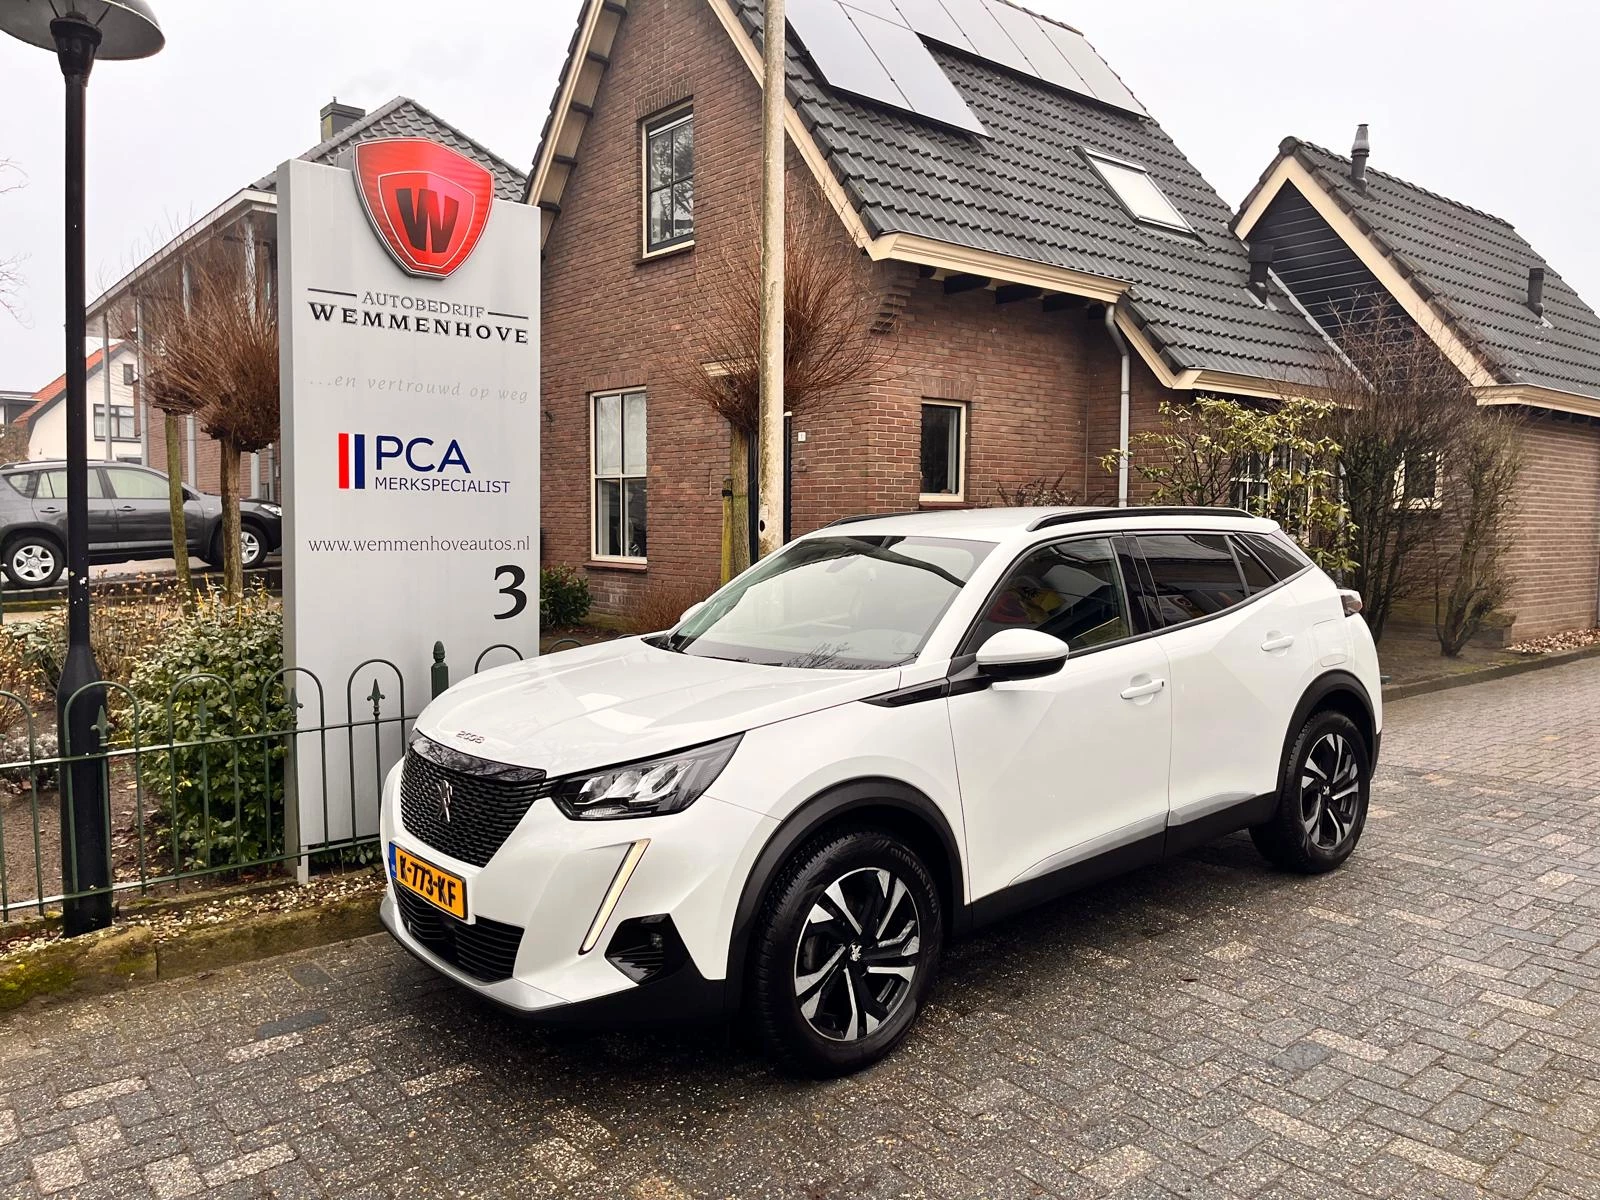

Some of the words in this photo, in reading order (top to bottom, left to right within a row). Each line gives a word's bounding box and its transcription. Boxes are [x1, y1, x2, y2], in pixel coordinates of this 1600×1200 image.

[395, 187, 460, 254] W
[307, 301, 529, 345] WEMMENHOVE
[361, 290, 486, 318] AUTOBEDRIJF
[367, 376, 462, 396] vertrouwd
[469, 385, 490, 401] op
[497, 388, 529, 404] weg
[375, 434, 472, 474] PCA
[374, 476, 511, 493] MERKSPECIALIST
[308, 535, 531, 552] www.wemmenhoveautos.nl
[493, 564, 528, 620] 3
[399, 854, 457, 909] K-773-KF
